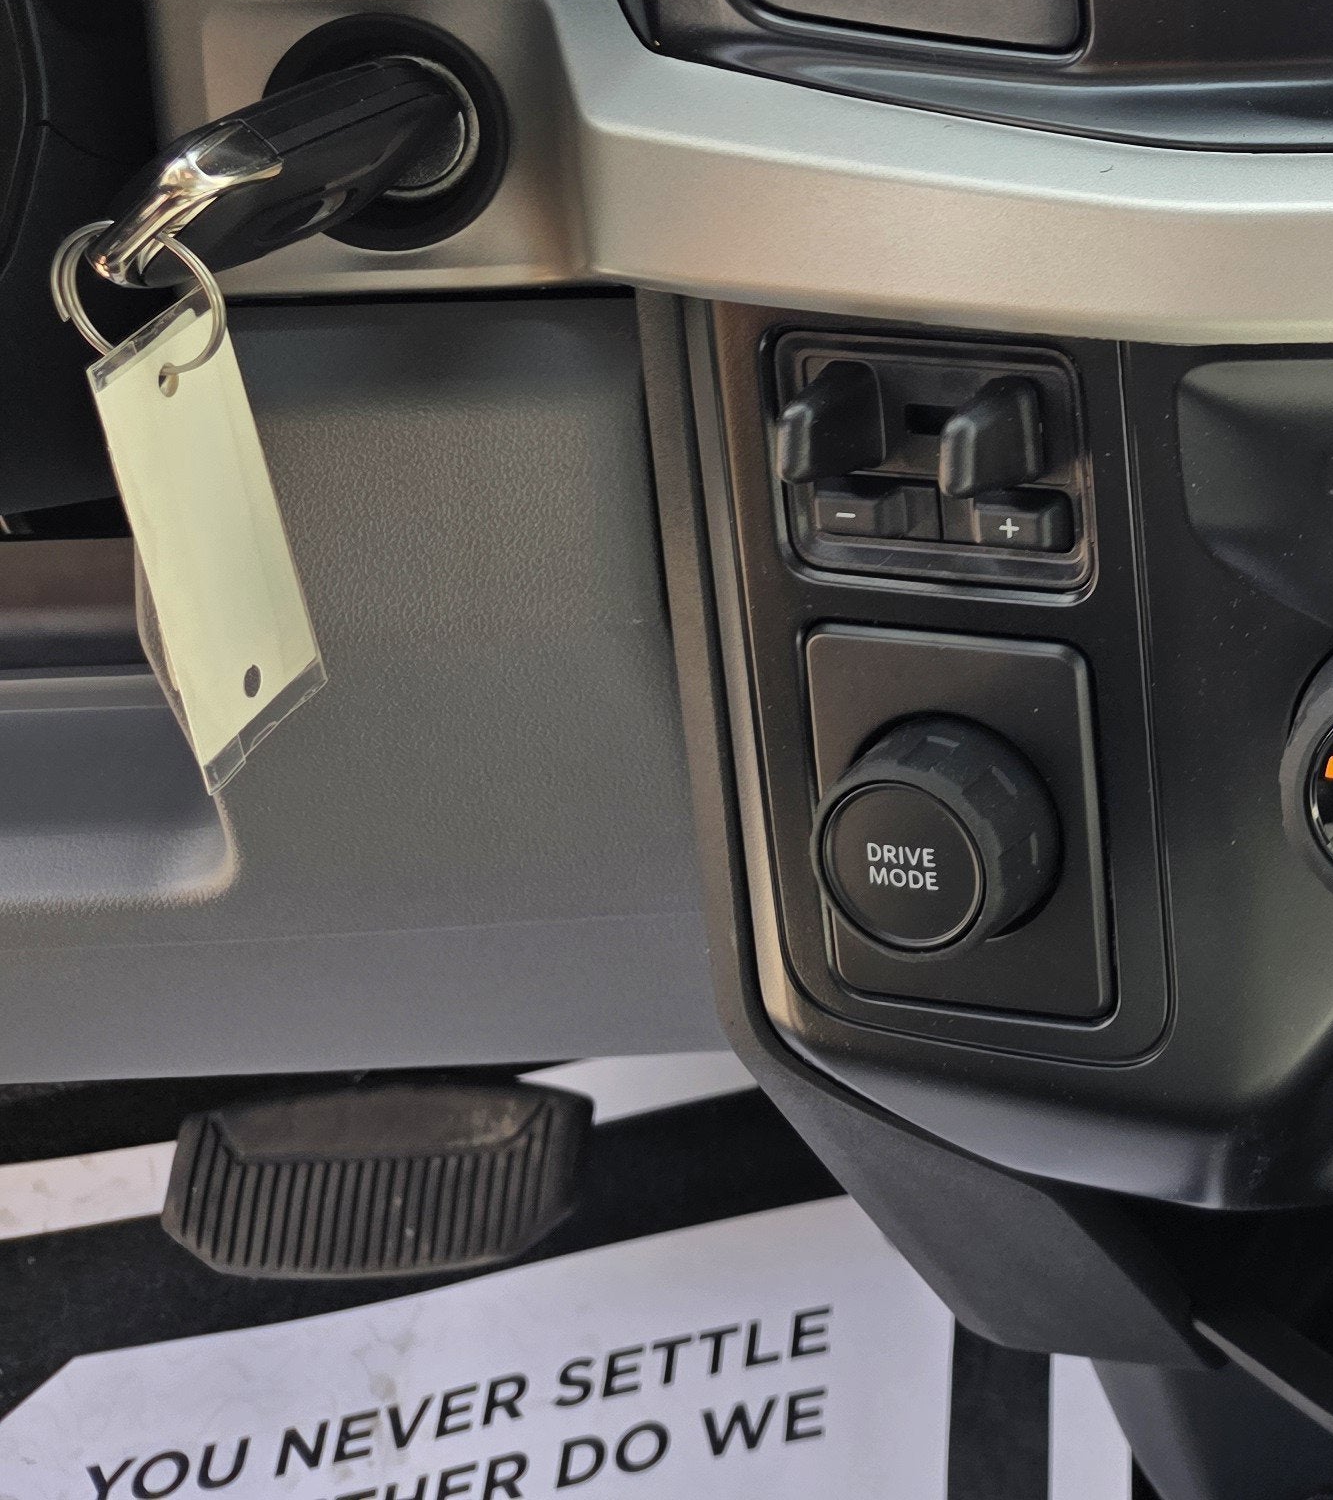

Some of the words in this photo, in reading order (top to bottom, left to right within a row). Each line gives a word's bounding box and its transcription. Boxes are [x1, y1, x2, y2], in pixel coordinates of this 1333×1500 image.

[866, 841, 936, 867] DRIVE
[869, 865, 939, 891] MODE
[86, 1436, 250, 1500] YOU
[274, 1373, 527, 1477] NEVER
[554, 1303, 832, 1407] SETTLE
[557, 1420, 670, 1488] DO
[702, 1387, 827, 1457] WE
